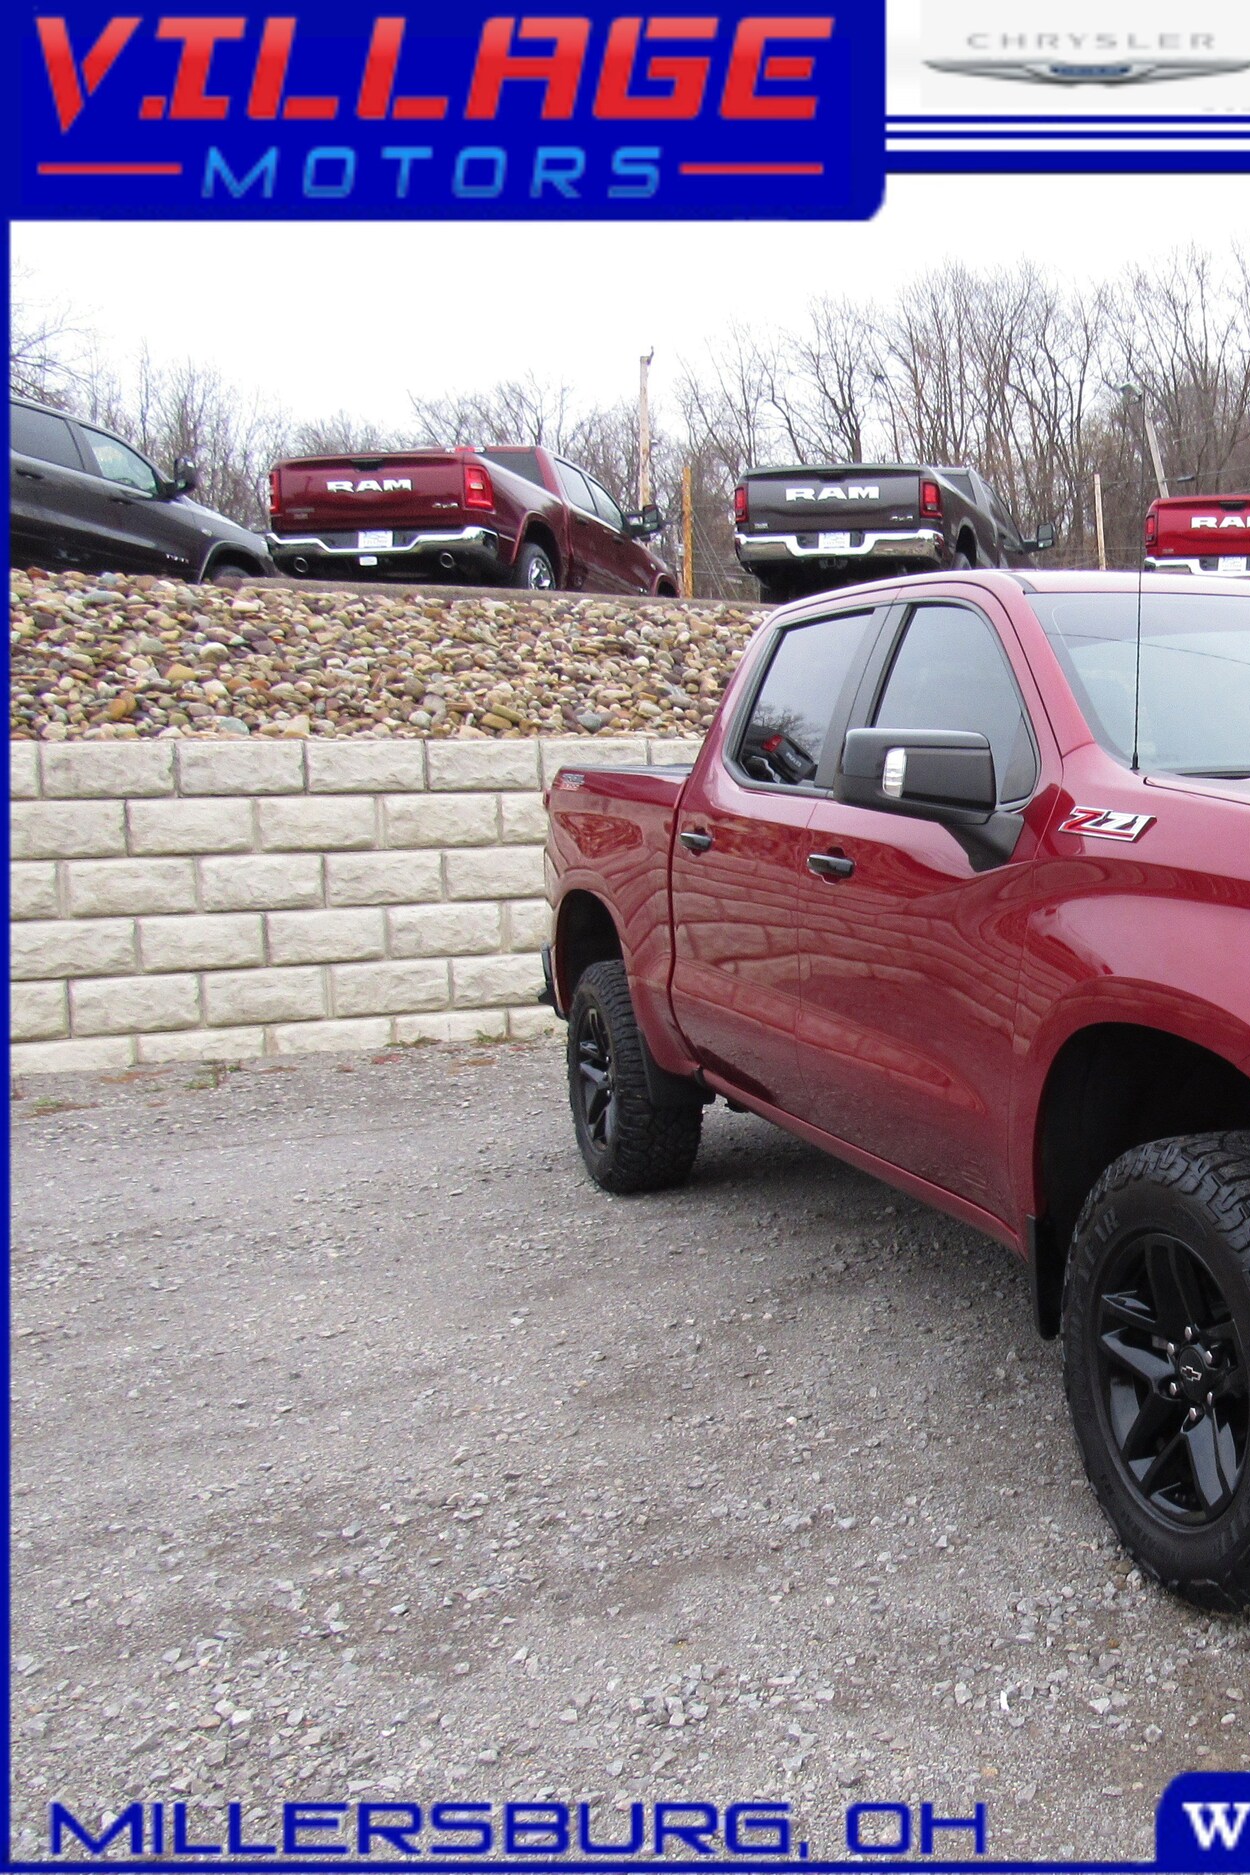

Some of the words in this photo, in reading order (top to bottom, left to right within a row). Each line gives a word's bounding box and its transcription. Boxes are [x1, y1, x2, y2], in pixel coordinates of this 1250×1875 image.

[326, 479, 412, 493] RAM
[785, 486, 880, 501] RAM
[1057, 805, 1157, 842] Z71
